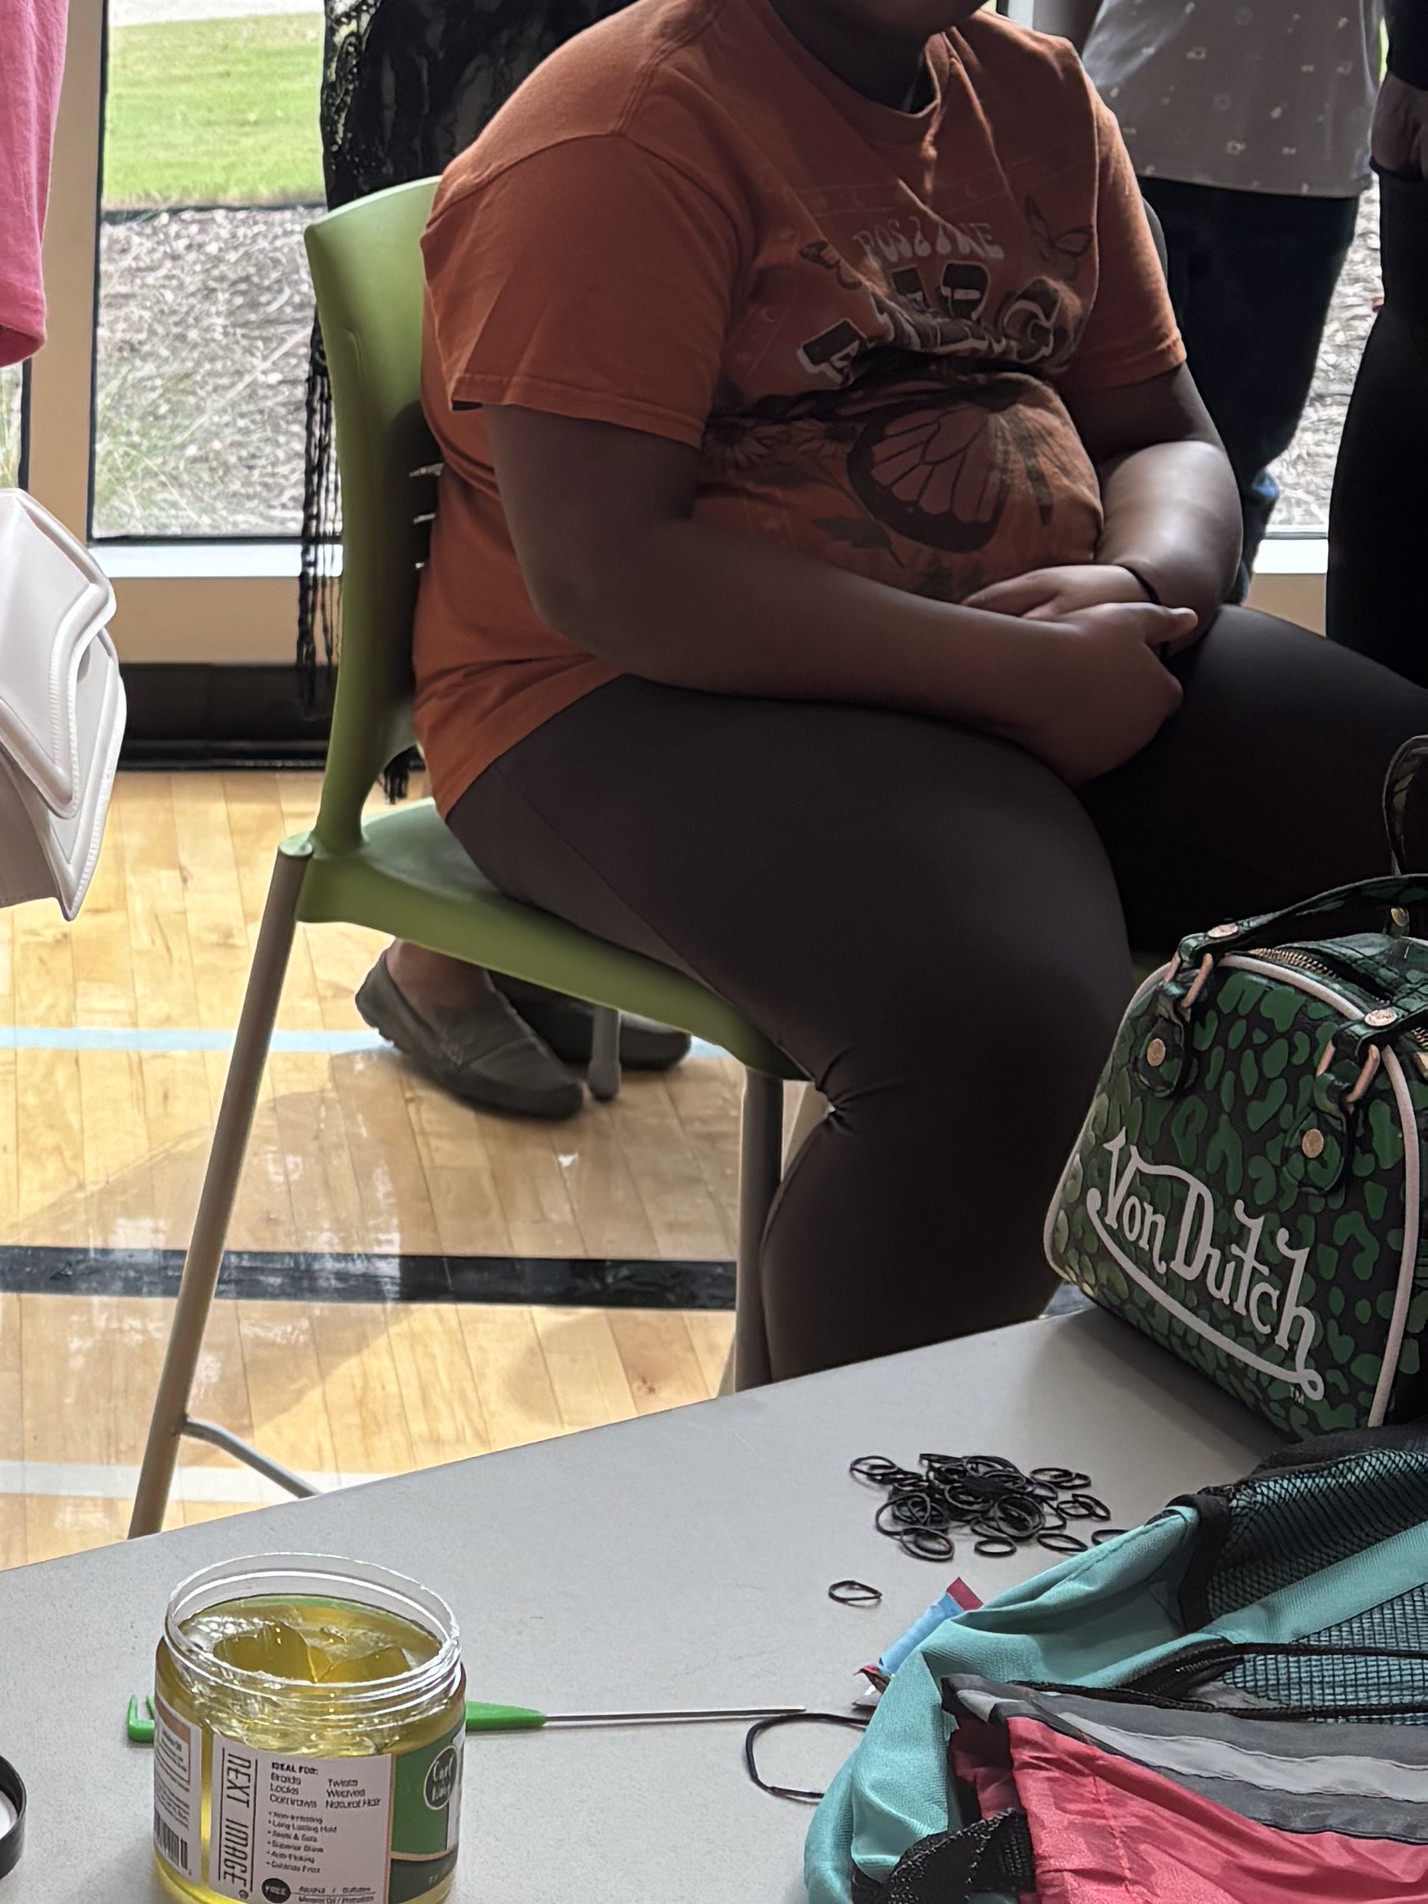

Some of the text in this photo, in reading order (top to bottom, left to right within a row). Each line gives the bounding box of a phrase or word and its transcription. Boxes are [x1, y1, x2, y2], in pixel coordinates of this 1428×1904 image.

[1101, 1127, 1317, 1372] Von Dutch
[223, 1752, 252, 1888] NEXT IMAGE
